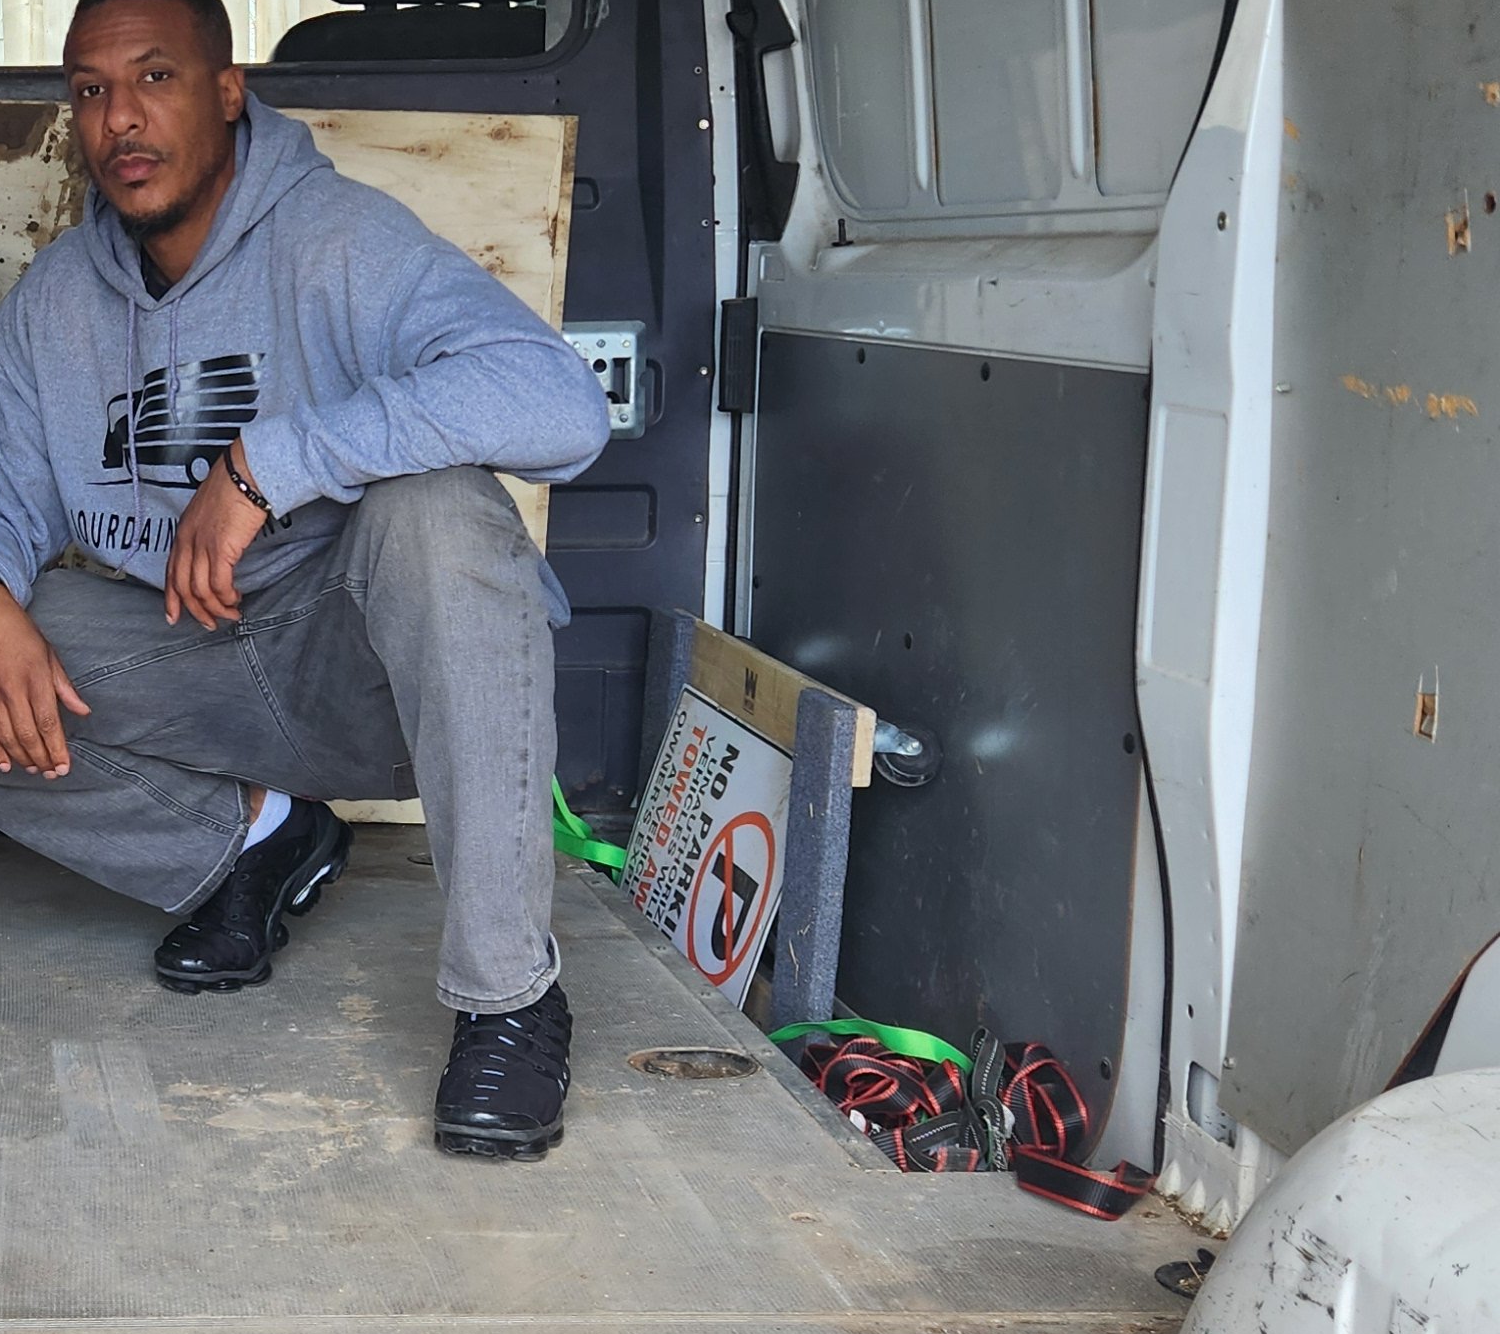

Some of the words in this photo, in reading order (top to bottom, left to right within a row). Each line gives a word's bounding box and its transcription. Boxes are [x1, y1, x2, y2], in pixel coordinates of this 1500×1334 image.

[643, 711, 687, 824] OWNER'S
[655, 725, 707, 847] TOWED
[663, 763, 677, 798] AT
[667, 736, 717, 856] VEHICLES
[710, 743, 740, 800] NO
[624, 831, 645, 885] EXP
[652, 758, 717, 928] UNAUTHORIZ
[661, 811, 713, 942] PARKI
